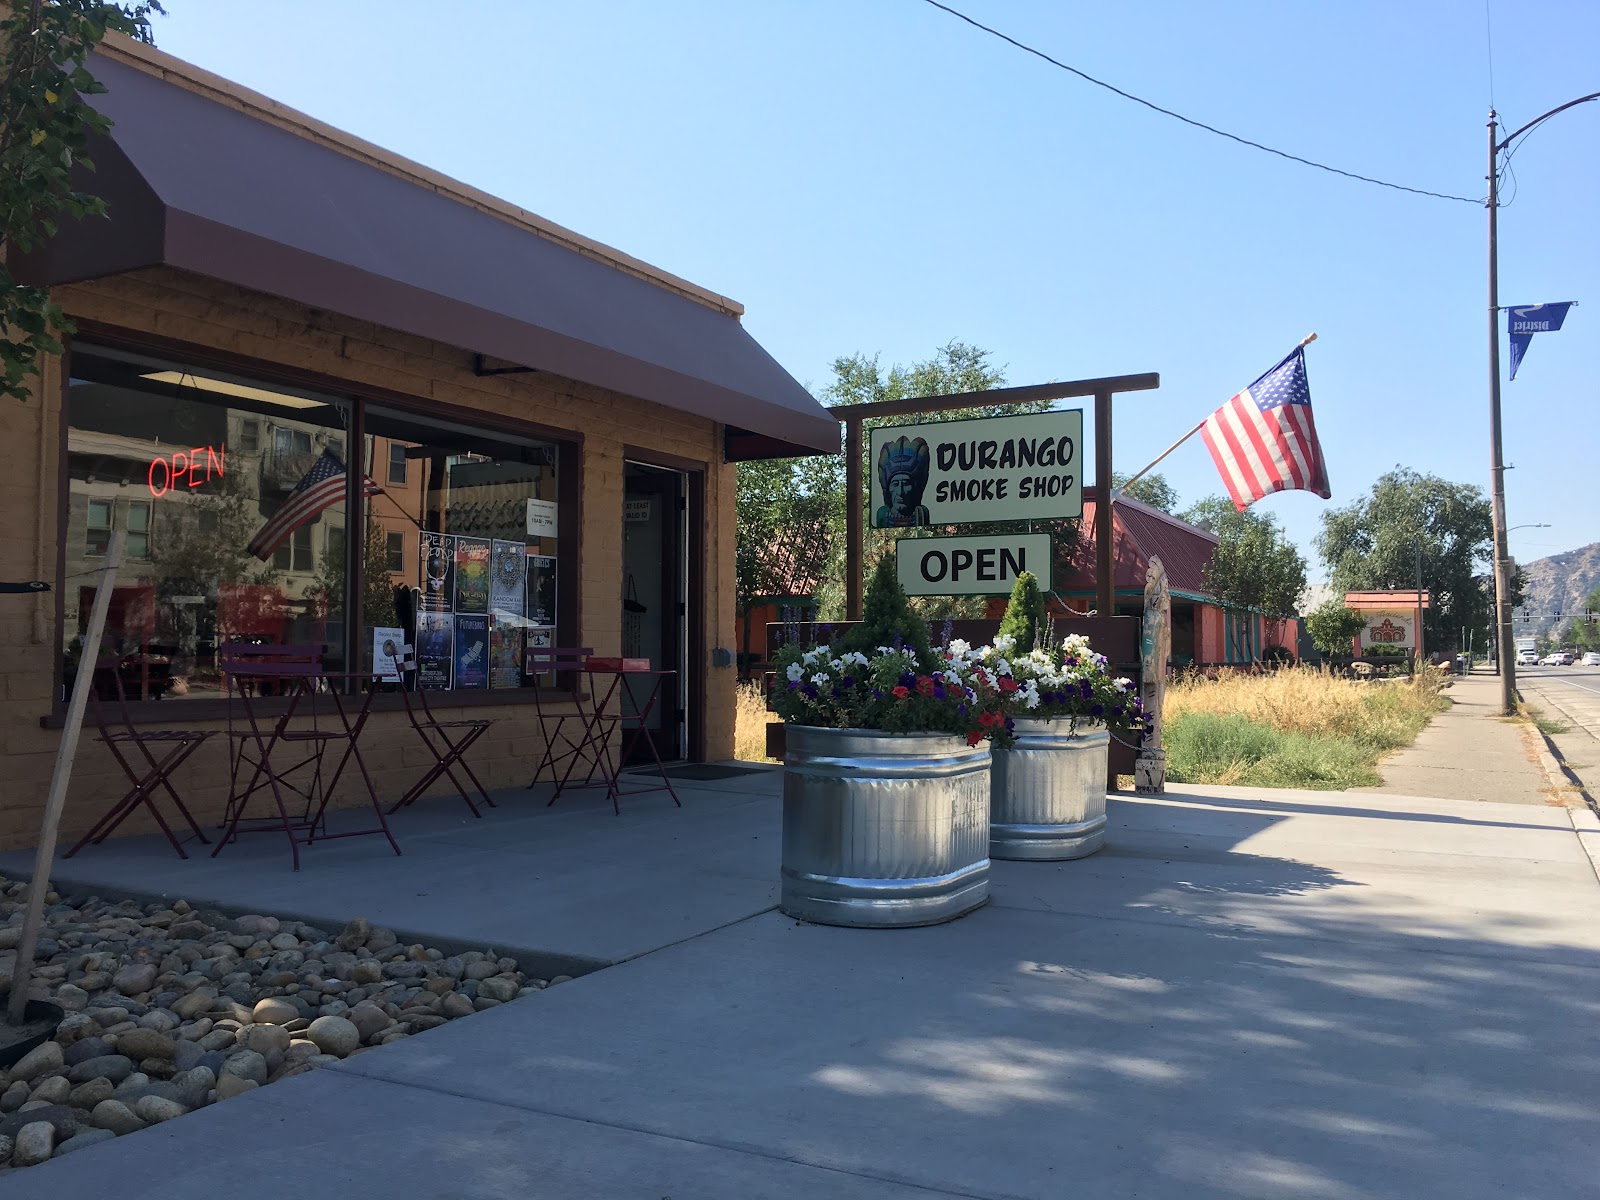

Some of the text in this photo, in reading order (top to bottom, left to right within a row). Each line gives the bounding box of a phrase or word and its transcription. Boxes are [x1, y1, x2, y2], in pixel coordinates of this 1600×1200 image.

[1513, 320, 1550, 331] District
[936, 436, 1074, 471] DURANGO
[148, 442, 225, 498] OPEN
[935, 474, 1074, 503] SMOKE SHOP
[459, 540, 486, 554] Reggae
[920, 547, 1026, 583] OPEN
